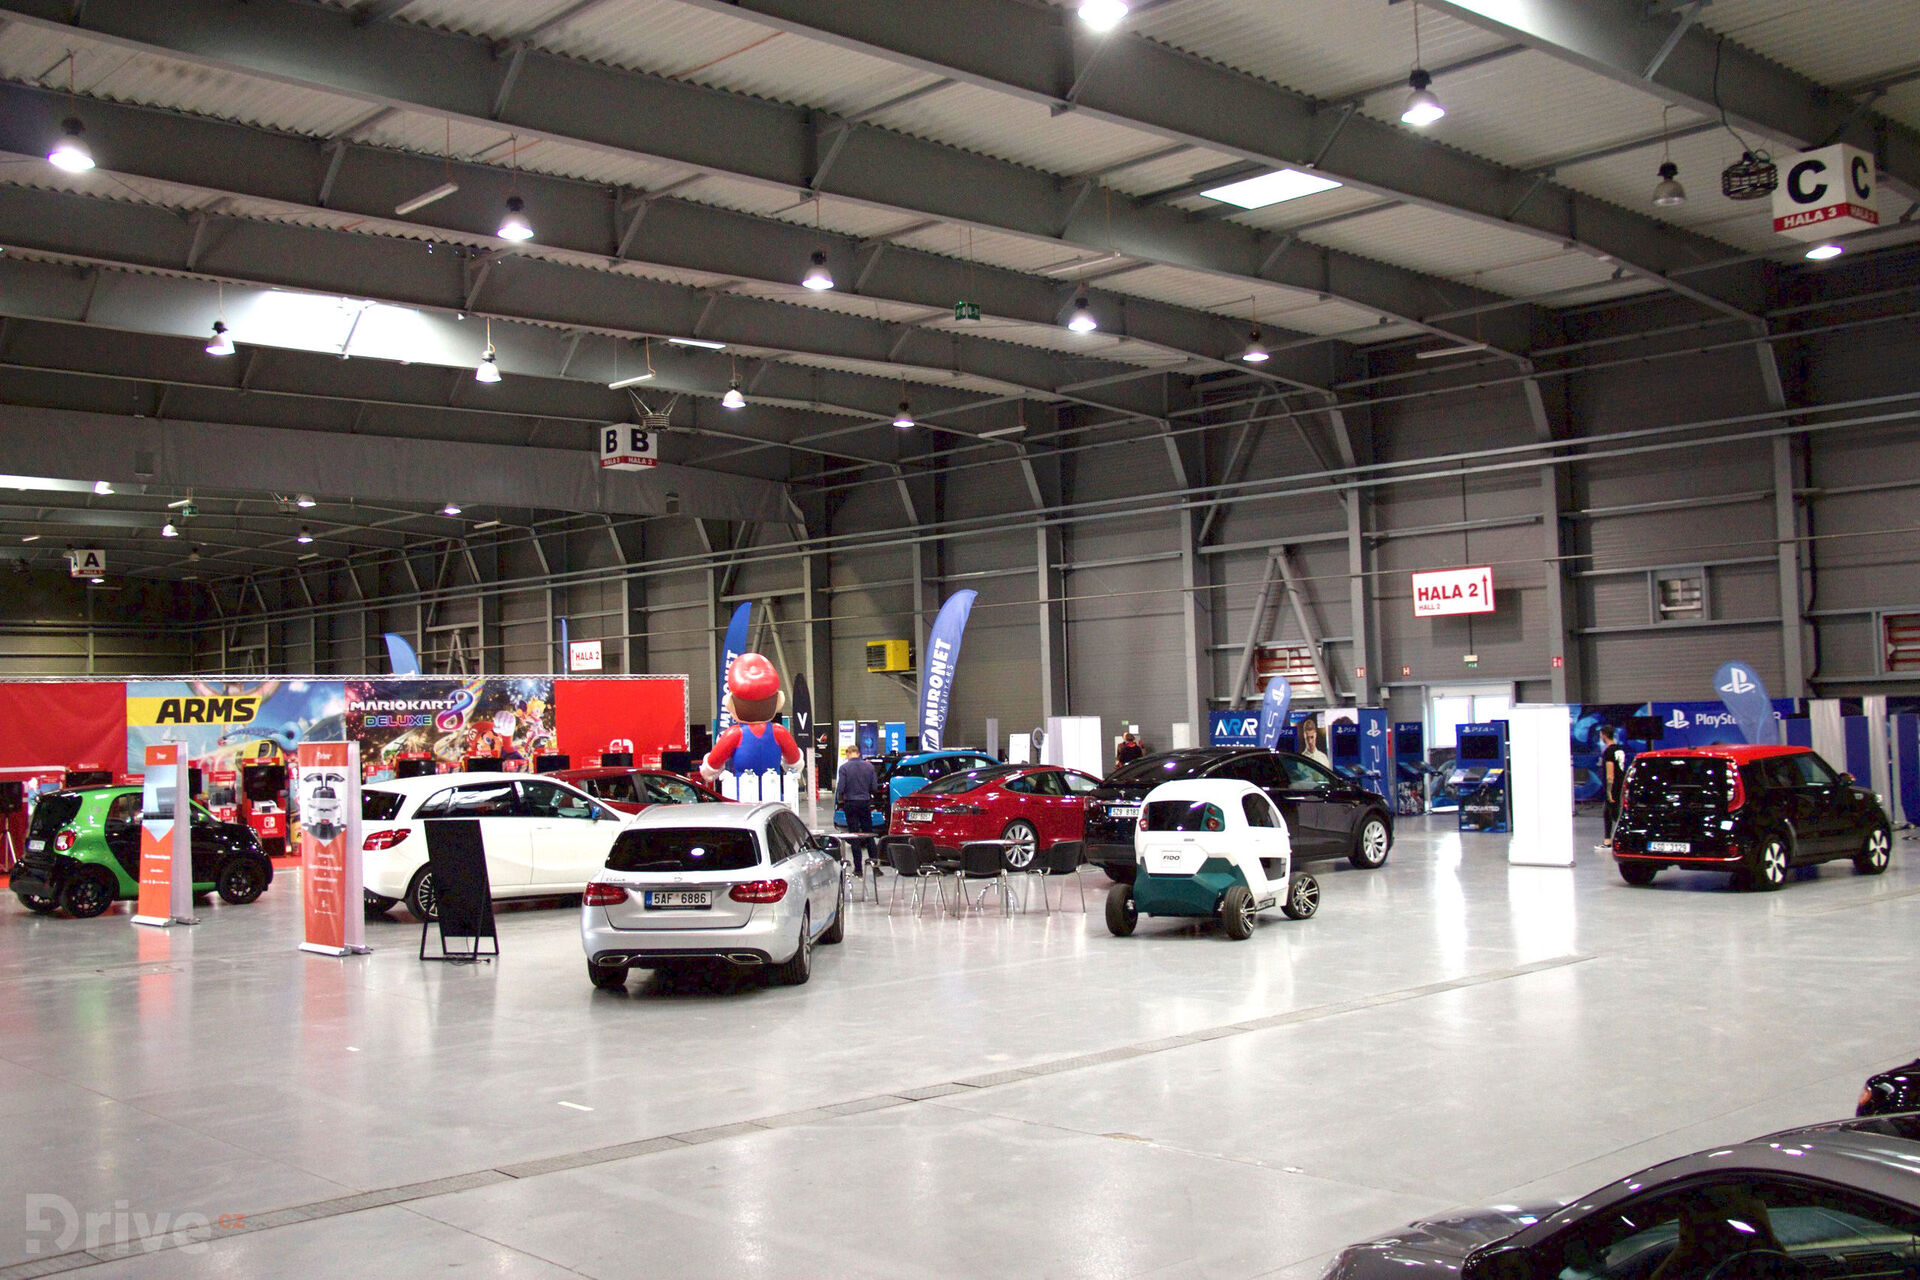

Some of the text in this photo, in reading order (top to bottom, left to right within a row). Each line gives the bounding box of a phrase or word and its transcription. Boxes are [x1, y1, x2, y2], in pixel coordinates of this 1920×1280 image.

[1787, 160, 1828, 204] C
[1851, 156, 1870, 200] C
[1784, 207, 1837, 229] HALA 3
[606, 429, 617, 454] B
[631, 429, 649, 452] B
[628, 457, 647, 465] HALA
[84, 552, 99, 567] A
[1417, 583, 1478, 601] HALA 2
[575, 651, 600, 661] HALA 2
[925, 637, 951, 728] MIRONET
[156, 698, 257, 724] ARMS
[364, 714, 433, 728] DELUXE
[654, 893, 706, 904] 5AF 6886
